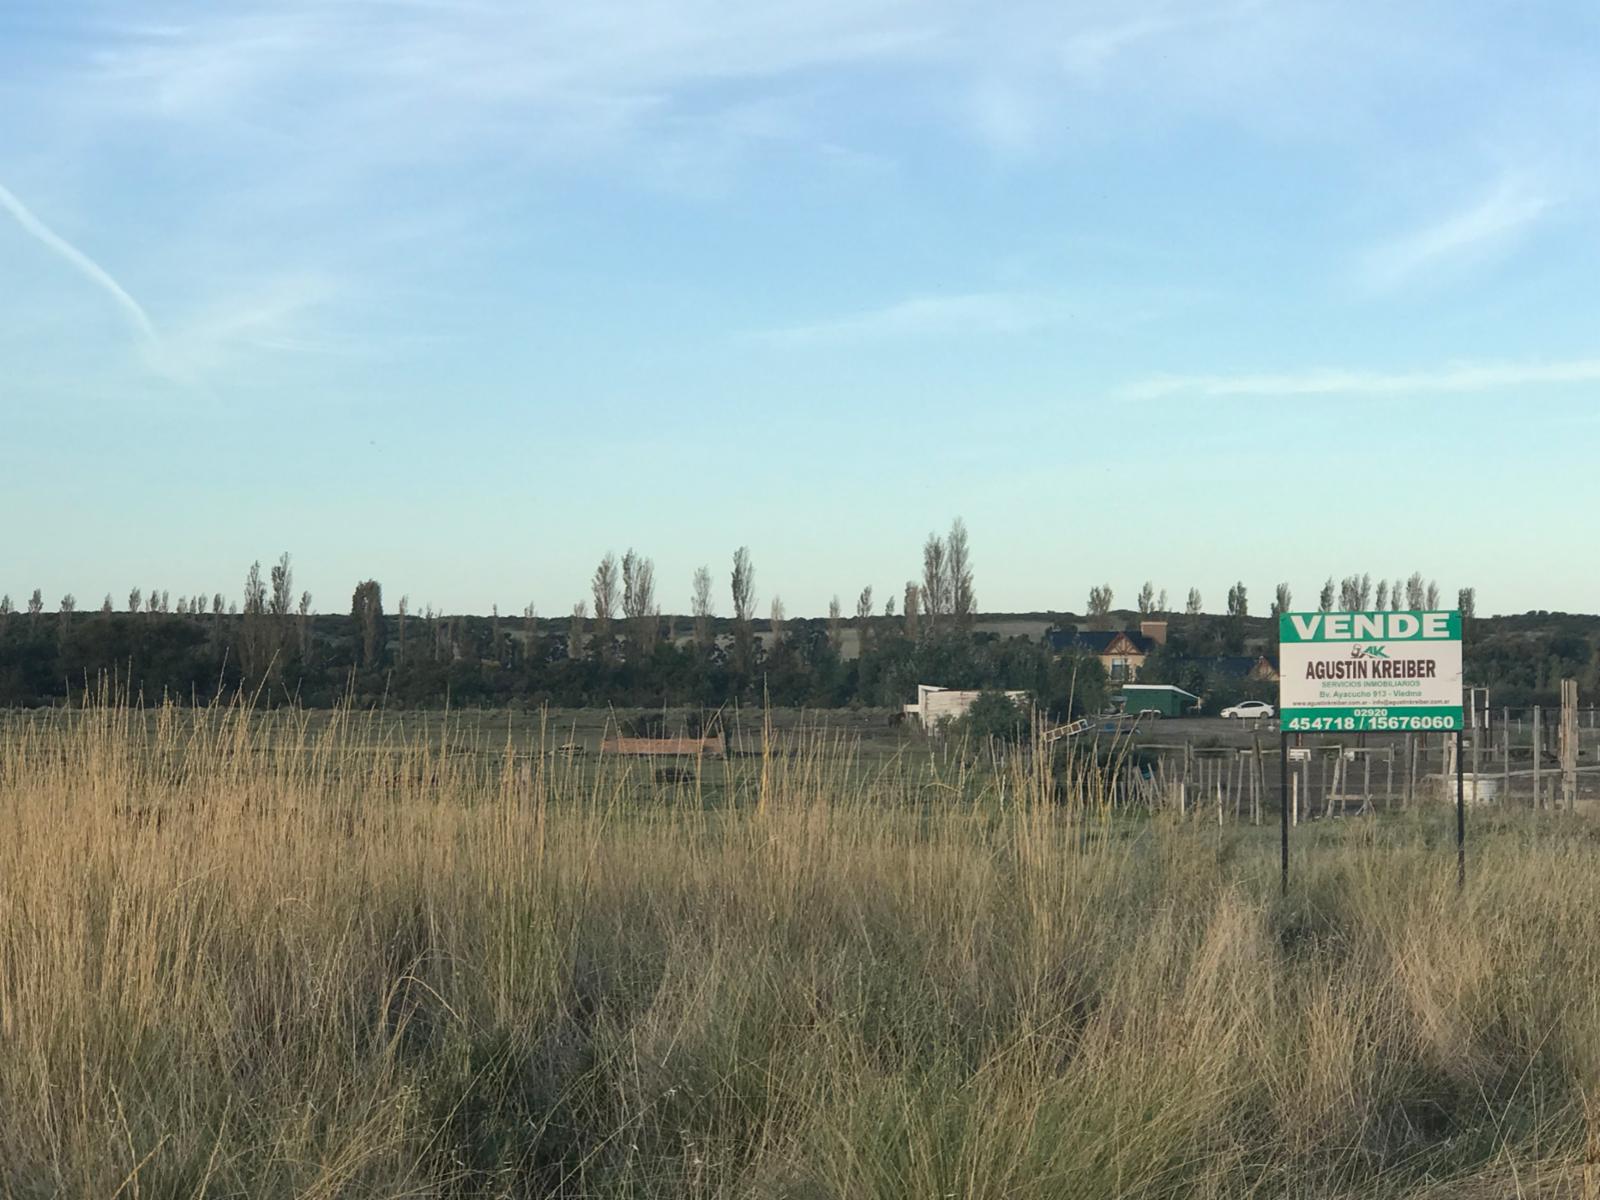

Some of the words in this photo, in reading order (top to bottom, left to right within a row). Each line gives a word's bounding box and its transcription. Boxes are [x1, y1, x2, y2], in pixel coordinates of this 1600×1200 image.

[1291, 613, 1450, 640] VENDE
[1306, 661, 1367, 679] AGUSTIN
[1373, 660, 1435, 678] KREIBER
[1289, 718, 1354, 730] 454718
[1359, 718, 1364, 729] /
[1368, 716, 1454, 729] 15676060
